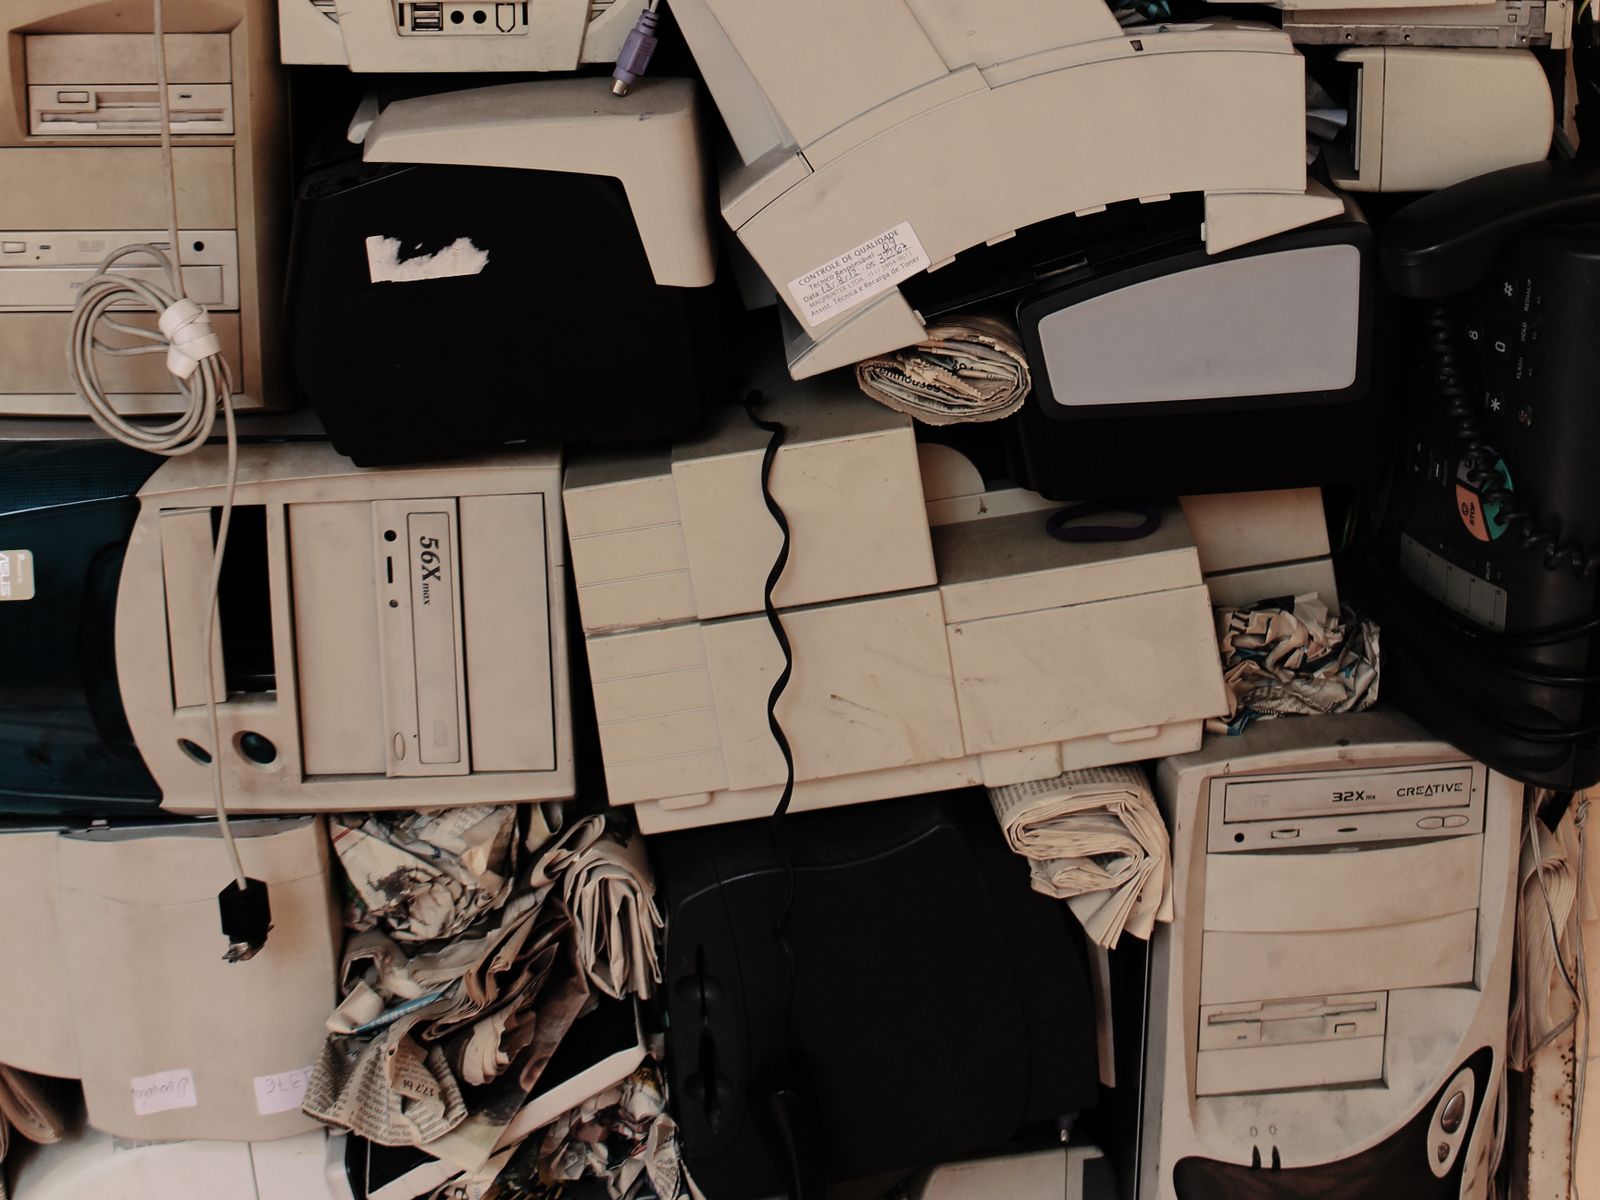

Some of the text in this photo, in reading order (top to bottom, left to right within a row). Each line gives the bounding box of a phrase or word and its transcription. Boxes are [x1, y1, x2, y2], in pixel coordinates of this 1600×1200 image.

[798, 229, 900, 286] CONTROLE DE QUALIDADE
[863, 271, 891, 289] Recarga
[899, 257, 920, 270] Toner
[1468, 329, 1479, 341] 8
[1495, 341, 1506, 353] 0
[419, 535, 441, 606] 56X max
[1332, 790, 1365, 803] 32X
[1396, 782, 1464, 798] CREATIVE
